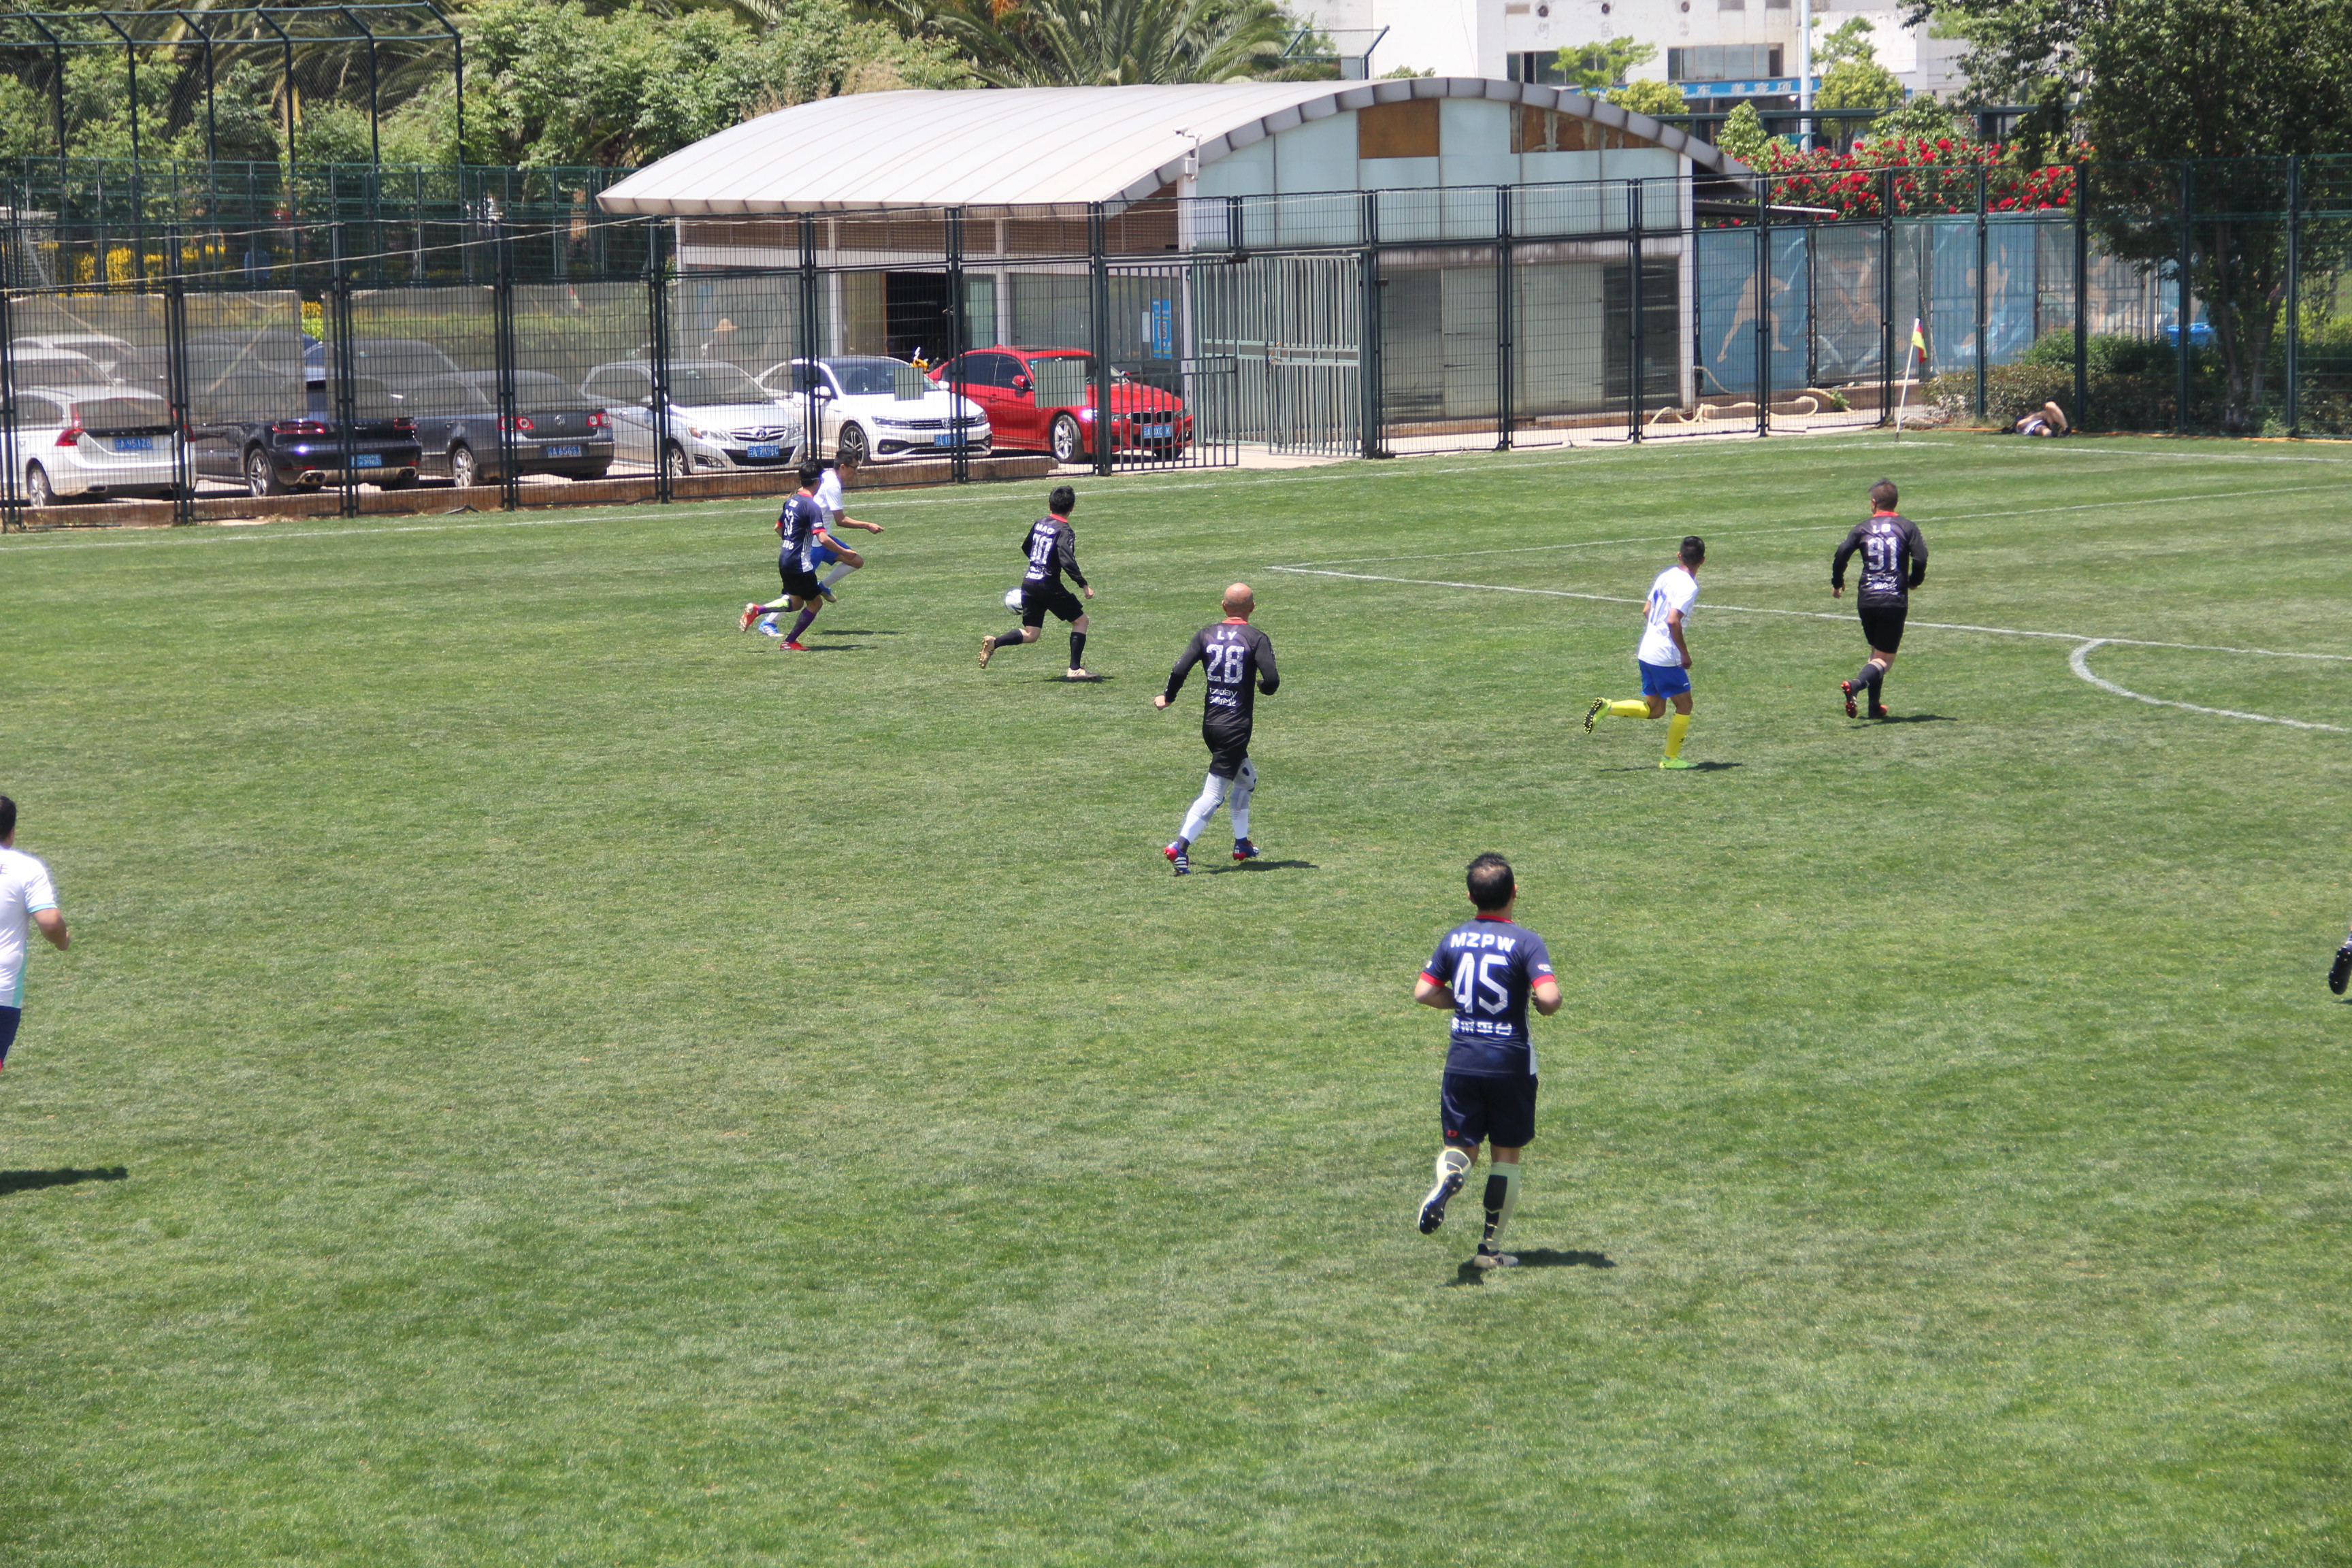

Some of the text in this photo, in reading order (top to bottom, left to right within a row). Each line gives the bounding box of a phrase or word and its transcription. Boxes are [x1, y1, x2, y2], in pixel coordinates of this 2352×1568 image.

[1867, 536, 1897, 571] 91
[1206, 644, 1245, 683] 28
[1450, 932, 1516, 952] MZPW
[1454, 952, 1509, 1015] 45
